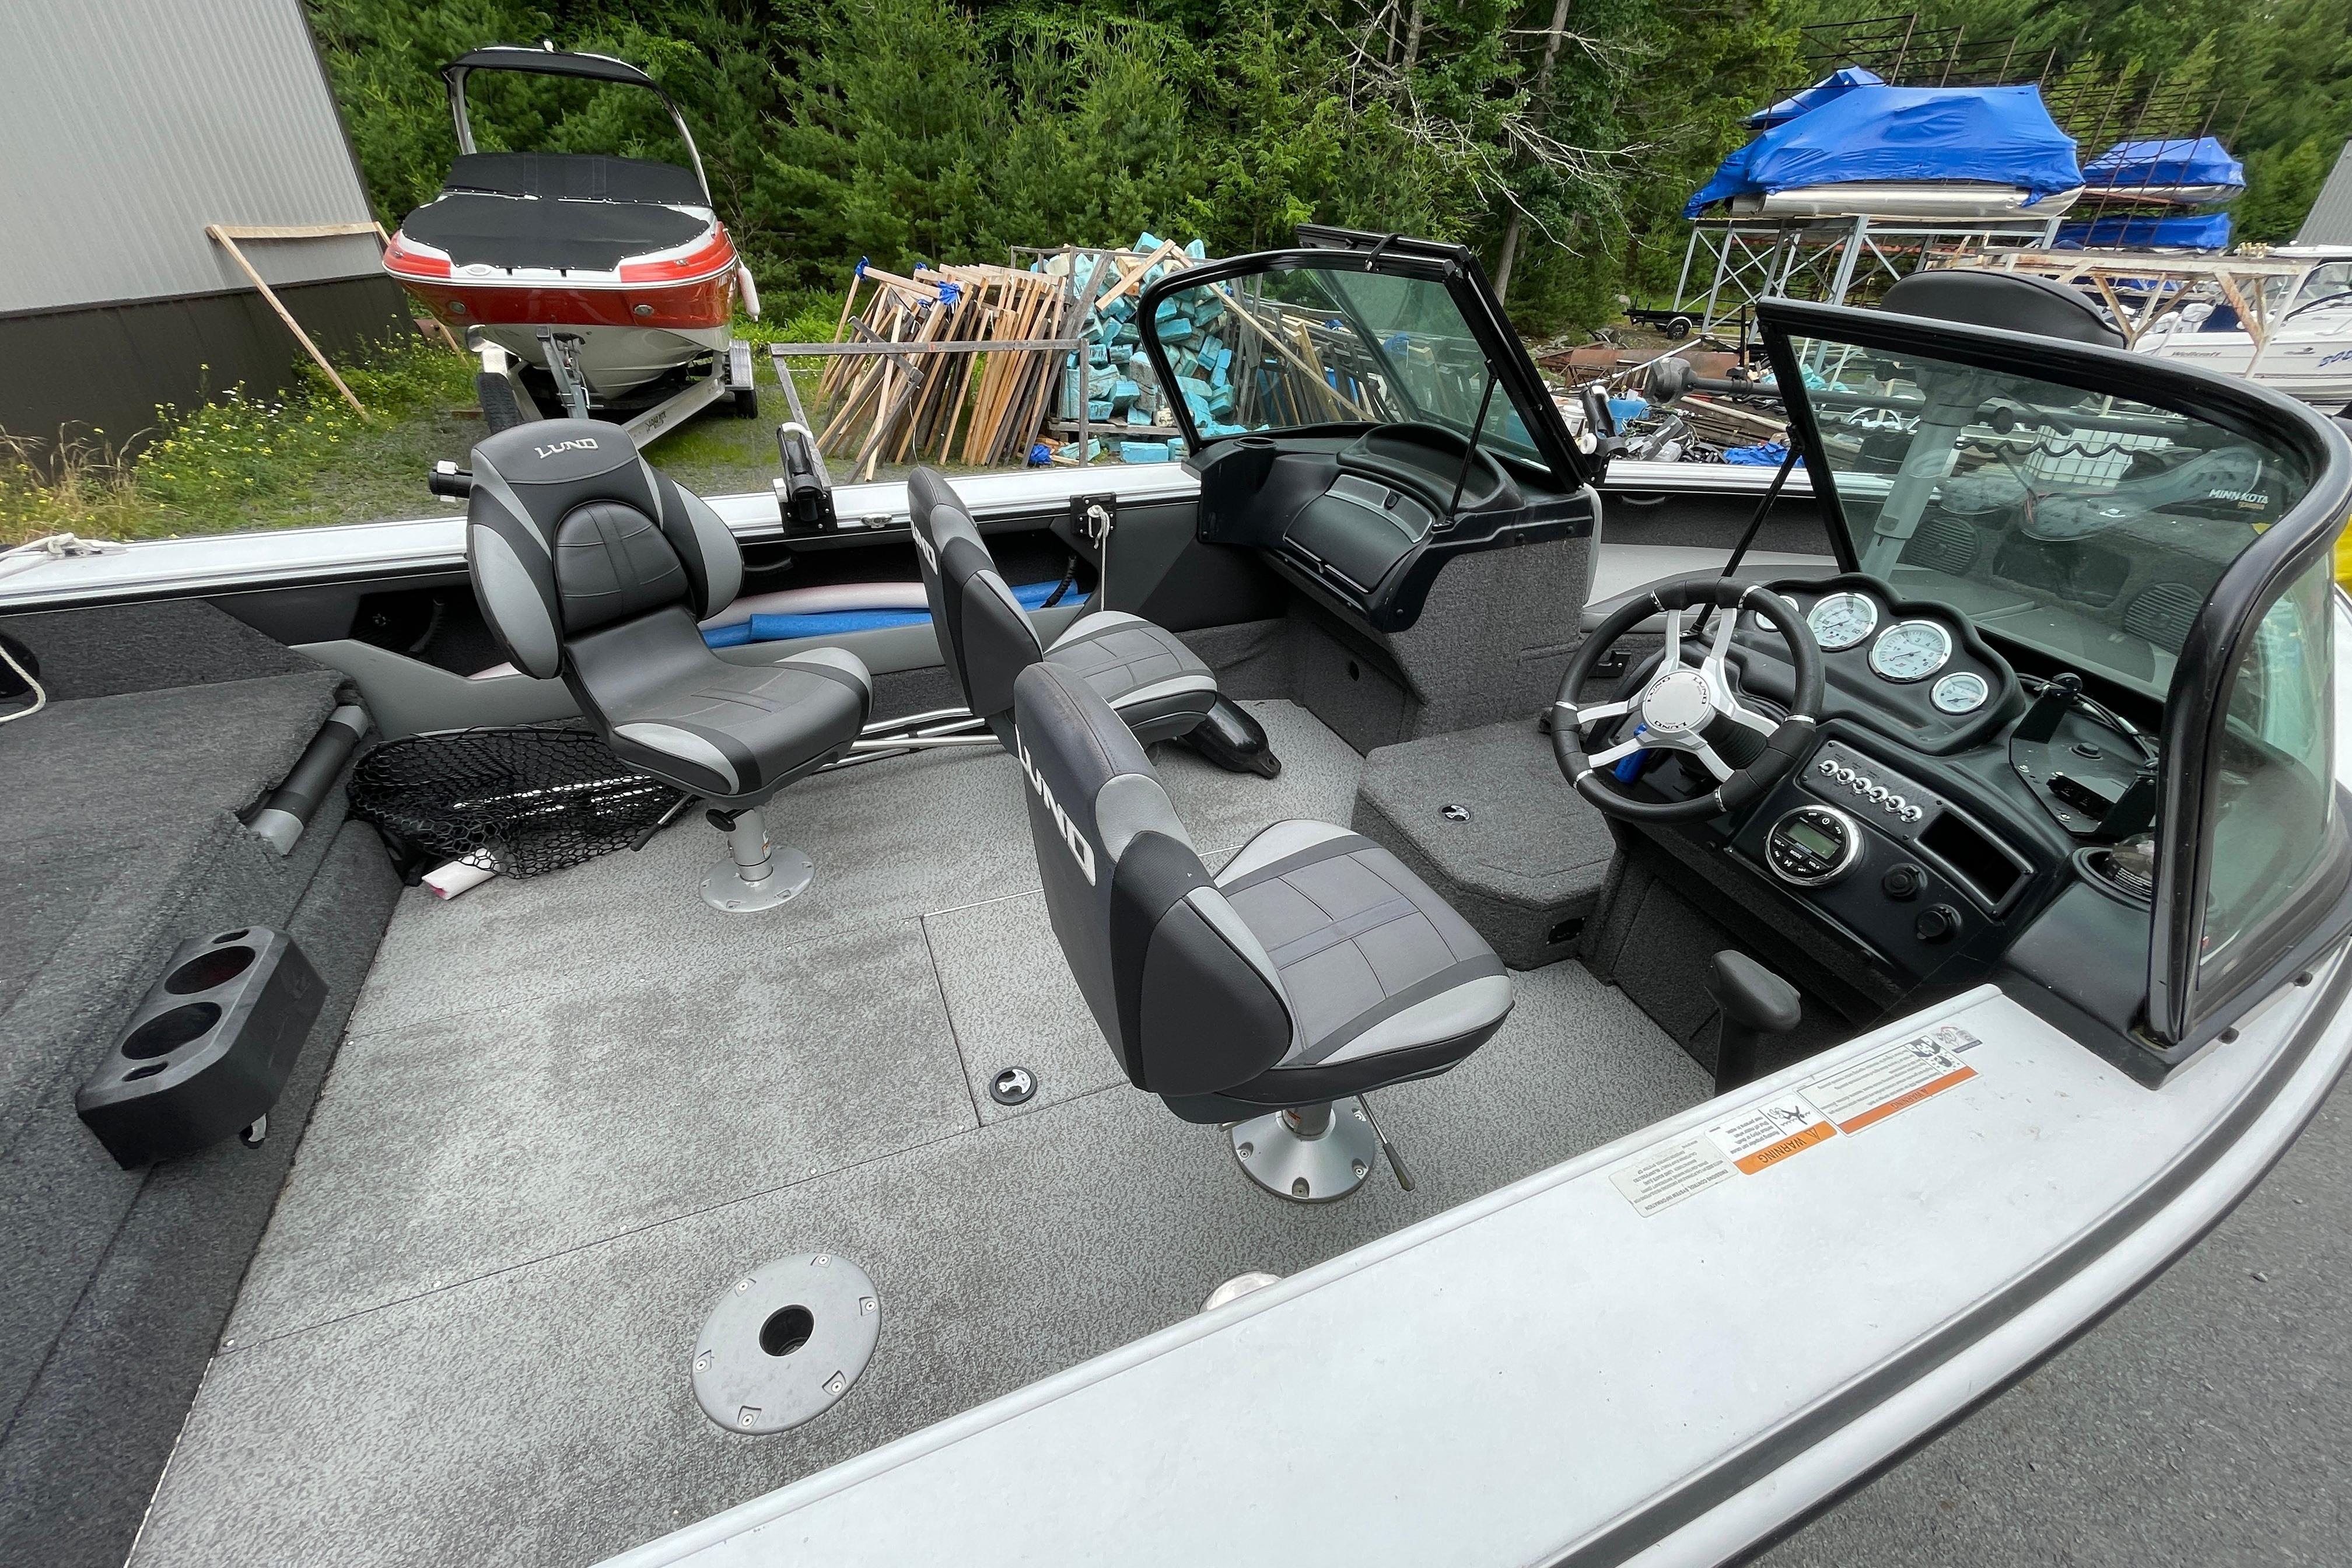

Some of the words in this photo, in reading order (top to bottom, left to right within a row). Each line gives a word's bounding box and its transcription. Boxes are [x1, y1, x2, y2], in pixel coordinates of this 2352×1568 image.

[534, 438, 598, 459] LUND
[2208, 489, 2241, 501] MINN
[2240, 492, 2269, 504] KOTA
[1647, 677, 1671, 702] LUND
[1692, 677, 1707, 704] LUND
[1654, 720, 1687, 729] LUND
[1015, 723, 1096, 887] LUND
[1889, 1091, 1923, 1110] WARNING
[1756, 1136, 1807, 1164] WARNING
[1686, 1178, 1708, 1190] CONTROL
